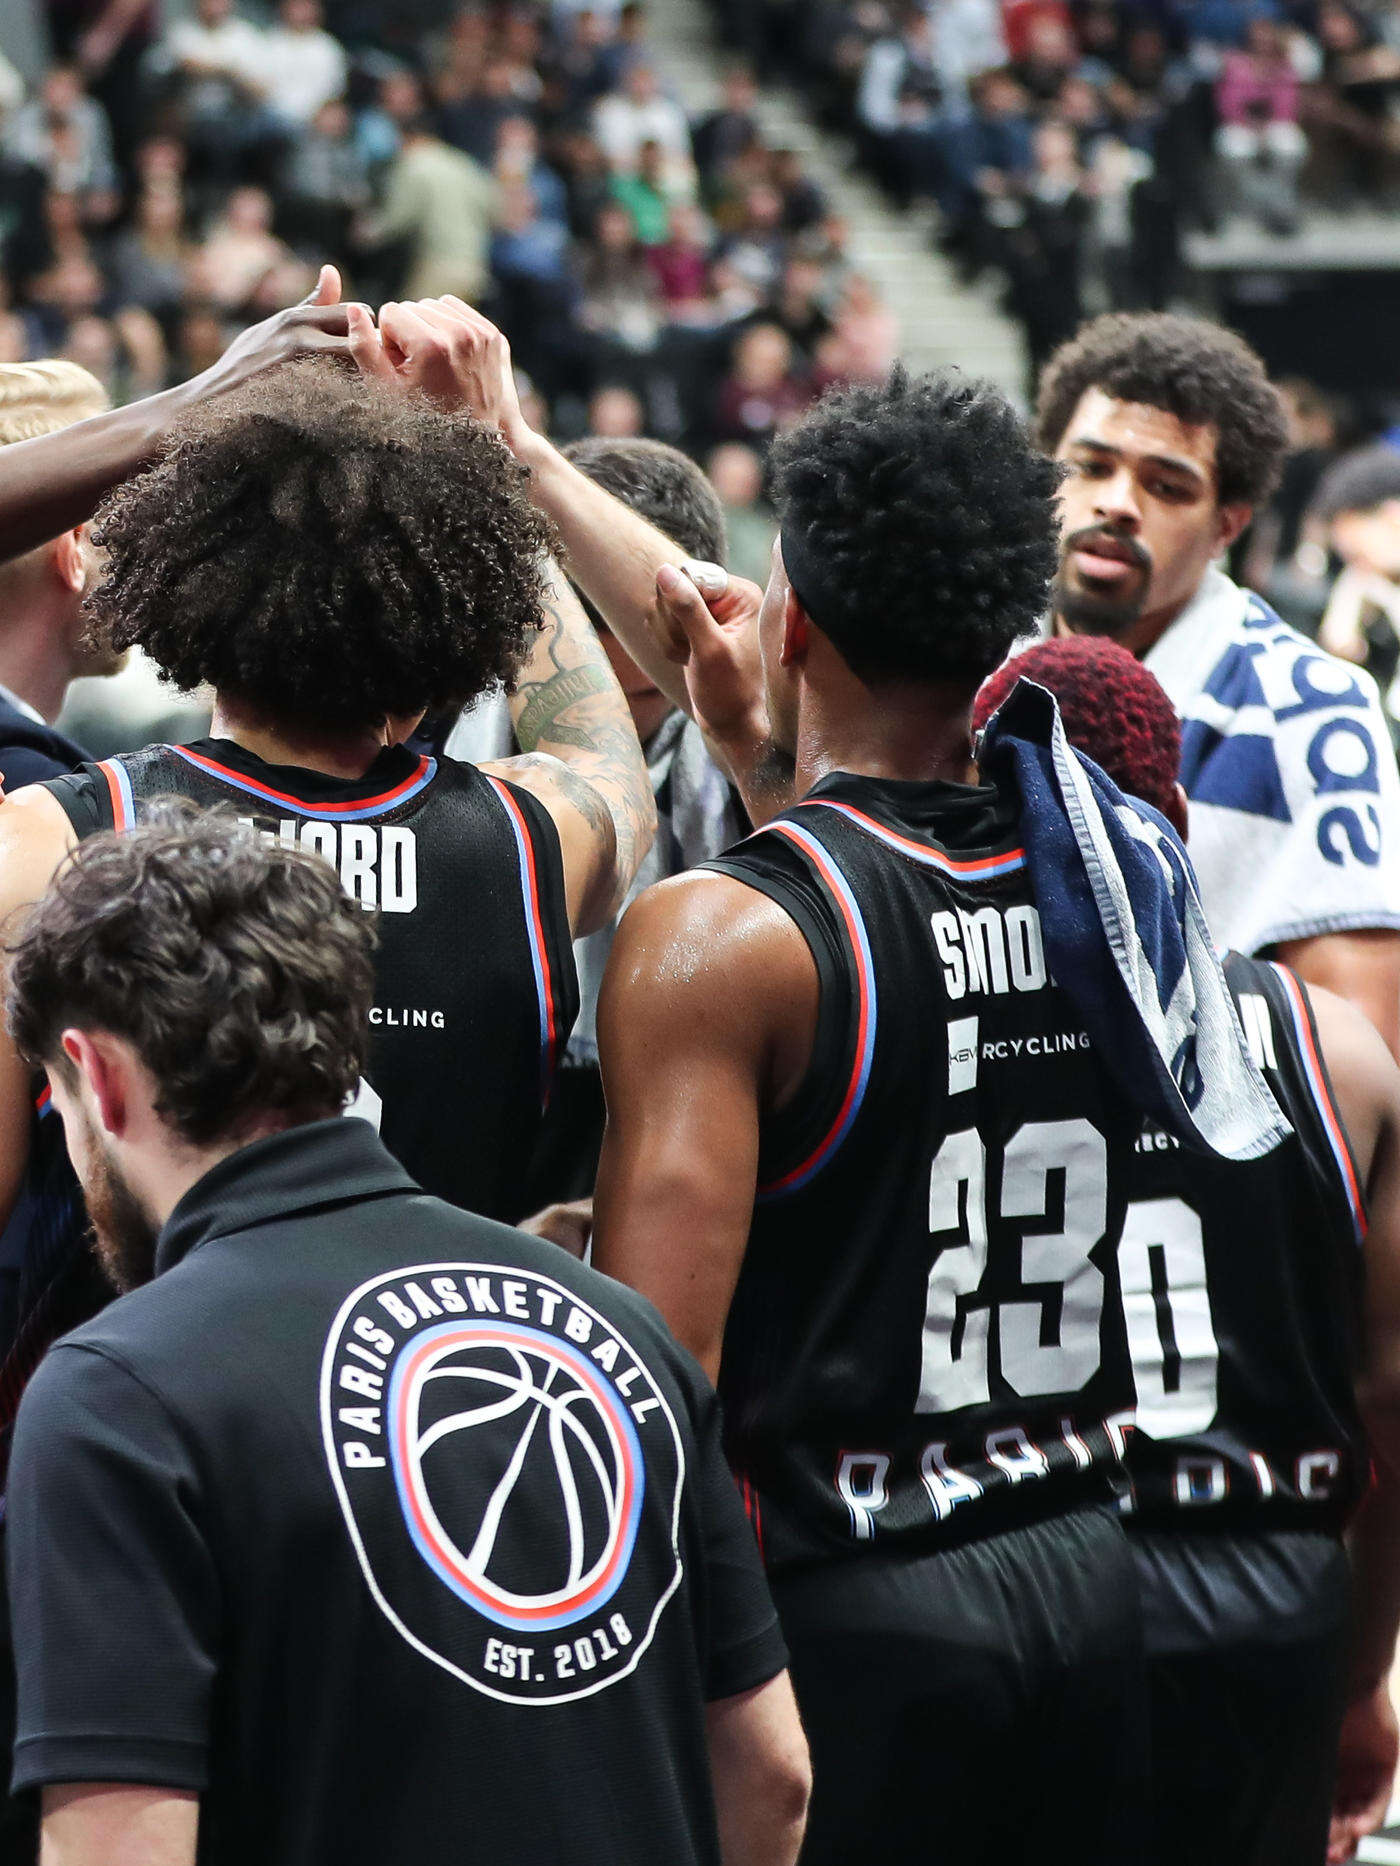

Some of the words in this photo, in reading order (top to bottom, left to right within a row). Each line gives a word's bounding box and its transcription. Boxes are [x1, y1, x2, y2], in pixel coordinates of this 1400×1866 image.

[368, 1007, 445, 1028] CLING
[930, 904, 1058, 1000] SMO
[913, 1118, 1107, 1414] 23
[1117, 1197, 1218, 1440] 0
[338, 1316, 395, 1468] PARIS
[377, 1276, 660, 1424] BASKETBALL
[484, 1637, 545, 1682] EST.
[554, 1613, 633, 1679] 2018
